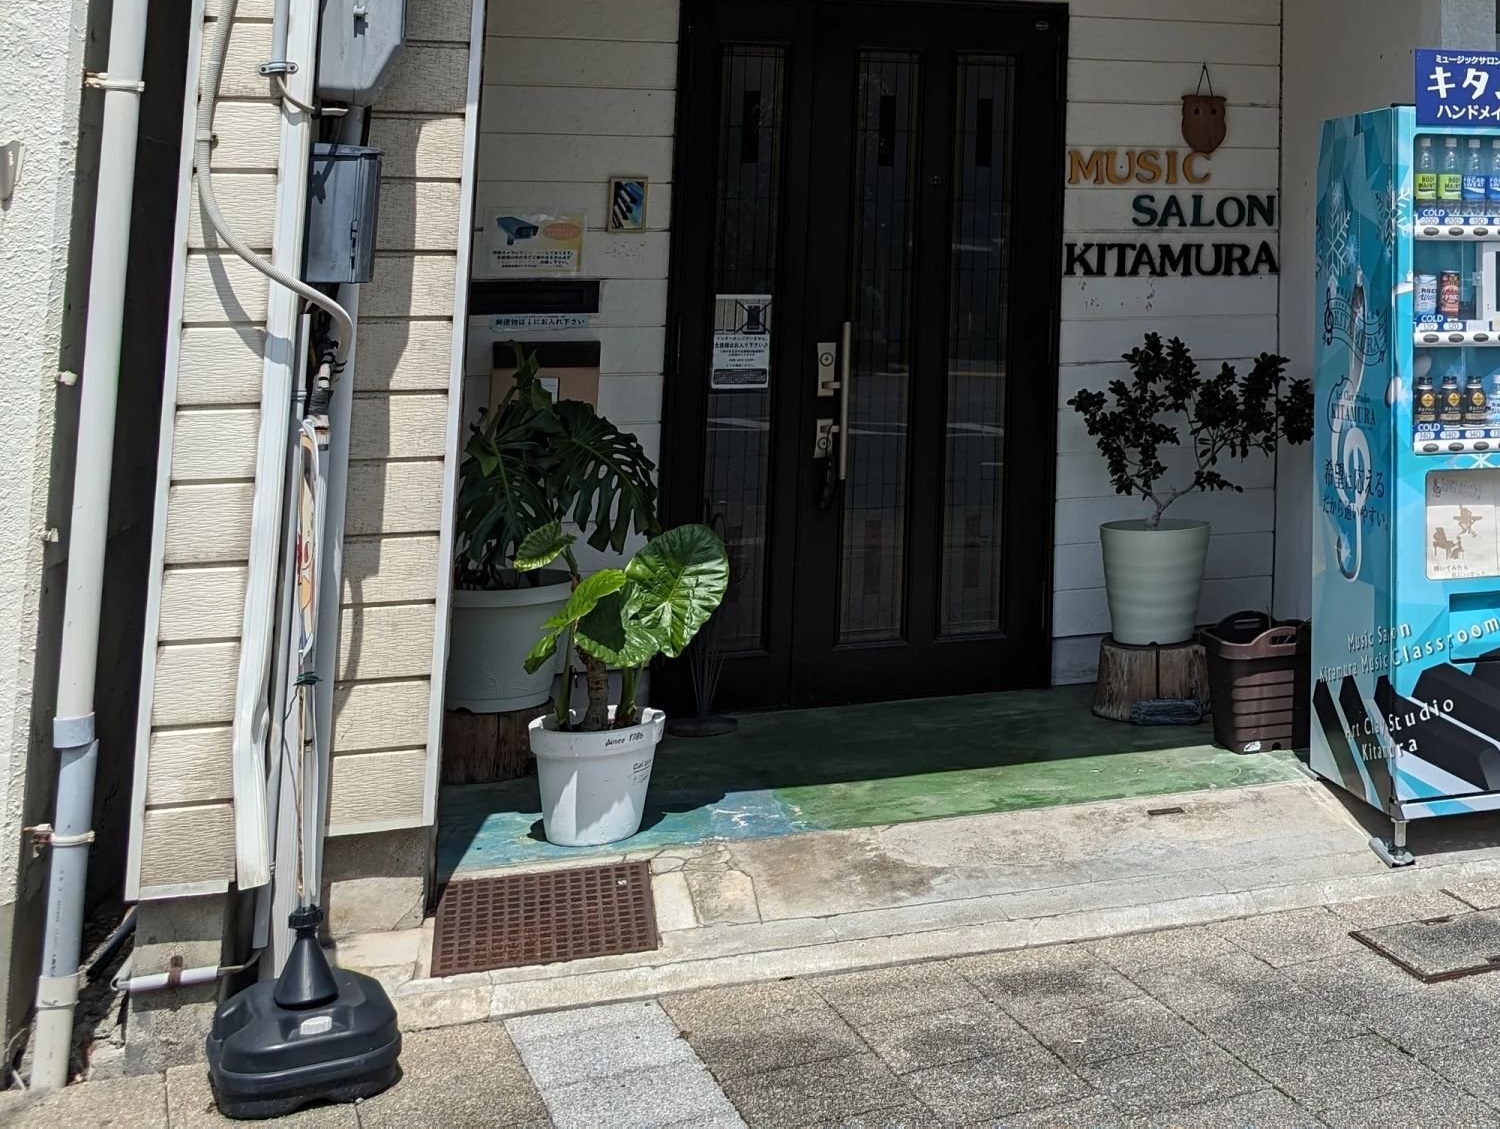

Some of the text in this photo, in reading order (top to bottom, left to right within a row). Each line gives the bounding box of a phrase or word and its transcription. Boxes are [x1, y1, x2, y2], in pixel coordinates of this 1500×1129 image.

[1068, 150, 1211, 185] MUSIC
[1132, 194, 1276, 227] SALON
[1423, 209, 1445, 217] COLD
[1063, 240, 1281, 277] KITAMURA
[1421, 314, 1443, 323] COLD
[1331, 403, 1376, 426] KITAMURA
[1418, 423, 1441, 431] COLD
[1324, 459, 1385, 498] 希望に応える
[1347, 630, 1374, 652] Music
[1360, 652, 1388, 673] Music
[1388, 698, 1454, 733] Studio
